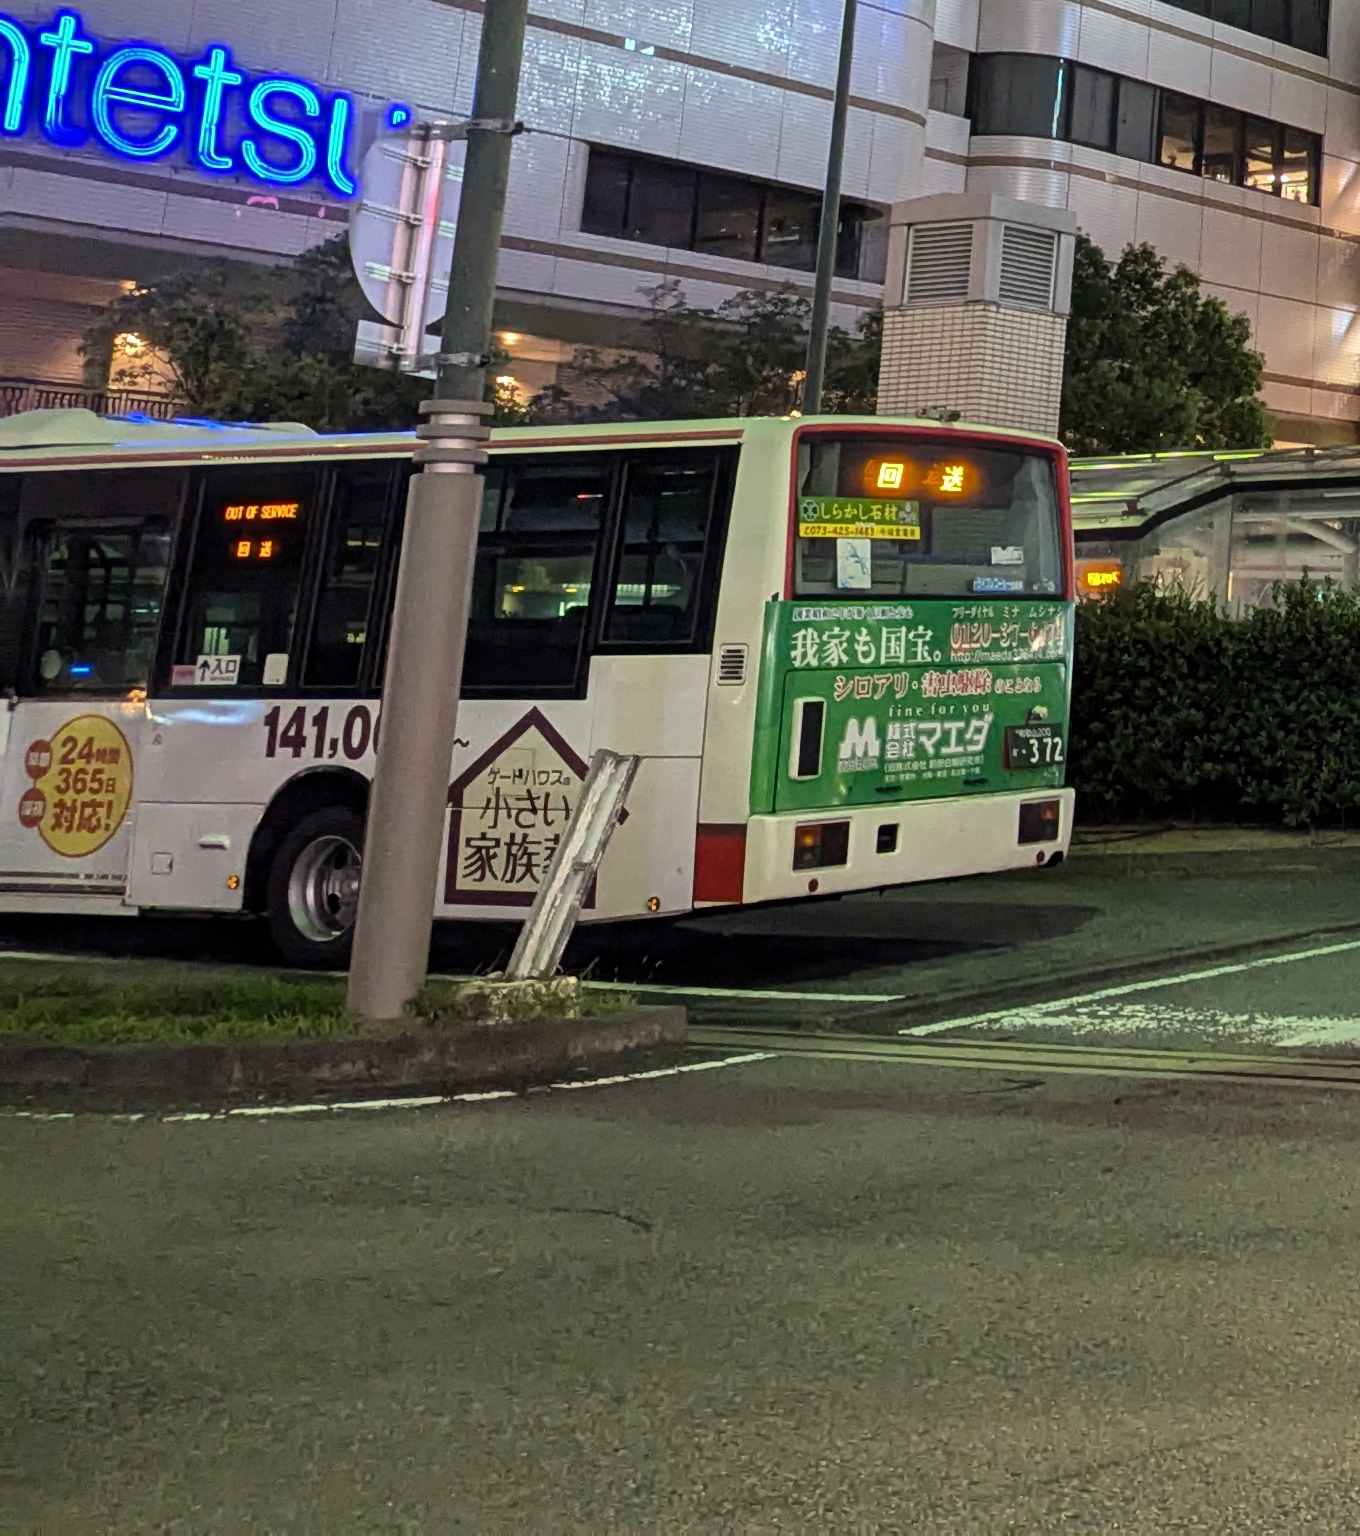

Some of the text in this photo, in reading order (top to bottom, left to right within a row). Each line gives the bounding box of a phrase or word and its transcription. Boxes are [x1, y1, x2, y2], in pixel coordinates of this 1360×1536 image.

[877, 463, 964, 492] 回送
[224, 503, 299, 520] OUT OF SERVICE
[820, 502, 899, 521] しらかし石材
[790, 625, 942, 668] 我家も国宝。
[211, 658, 237, 675] 入口
[888, 702, 991, 718] fine for you
[264, 705, 382, 760] 141,0
[918, 712, 995, 757] マエダ
[1028, 736, 1064, 764] 372
[55, 767, 117, 796] 365日
[50, 798, 114, 834] 対応!
[479, 786, 571, 830] 小さい
